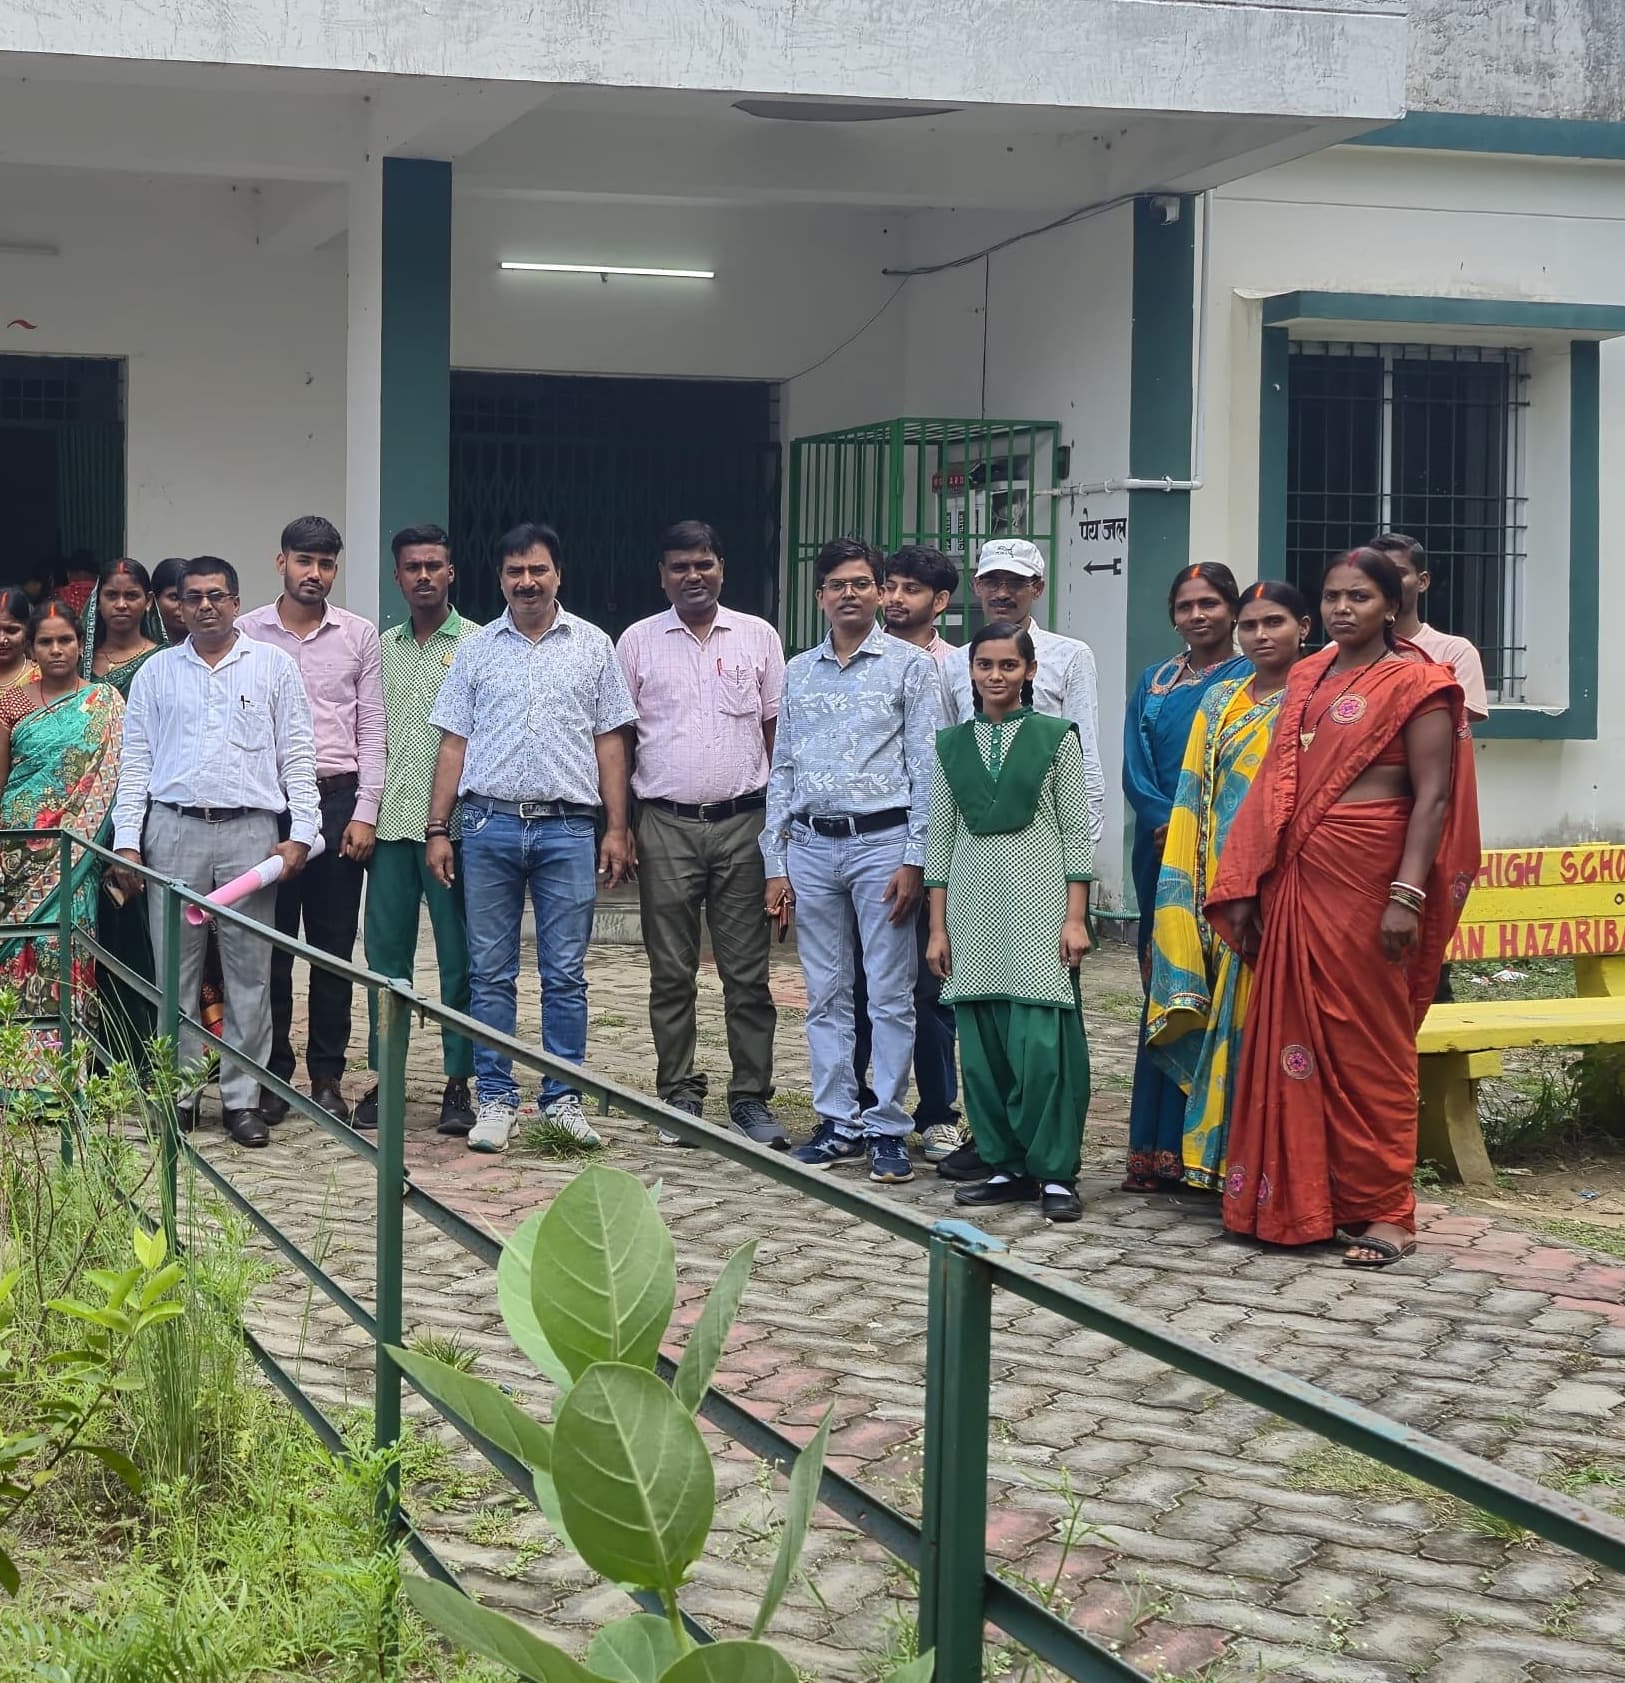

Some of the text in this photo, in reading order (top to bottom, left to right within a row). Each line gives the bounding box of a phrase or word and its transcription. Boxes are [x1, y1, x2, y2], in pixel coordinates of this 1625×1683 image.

[1079, 507, 1127, 544] पेय जल
[1473, 852, 1543, 888] HIGH
[1445, 924, 1485, 960] AN
